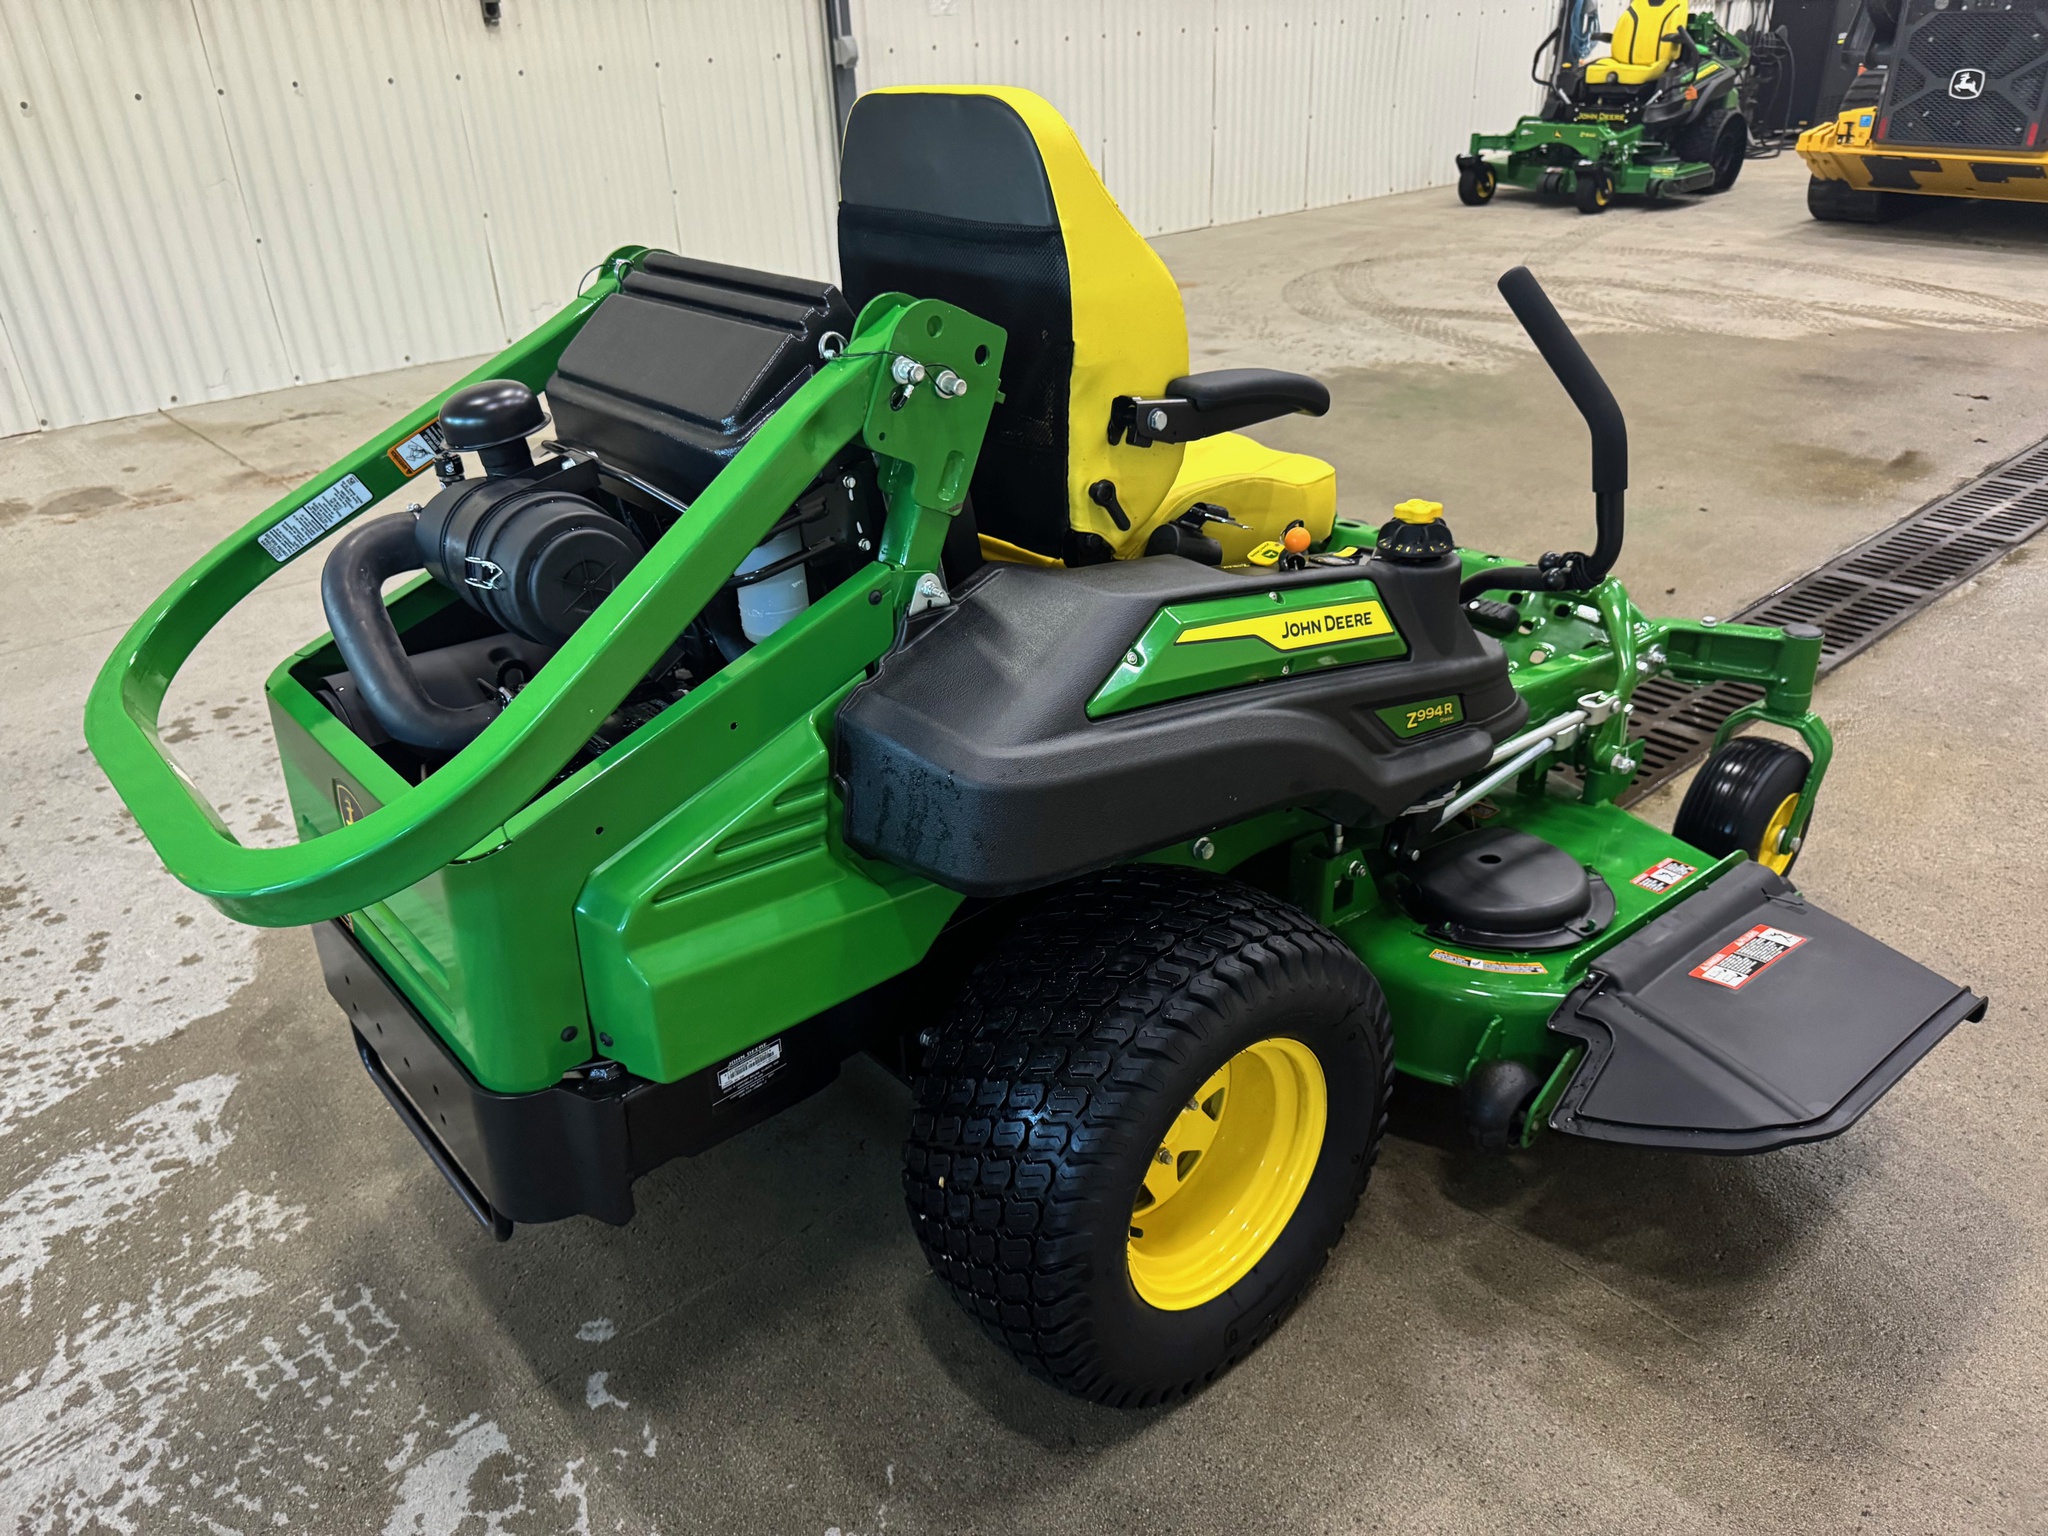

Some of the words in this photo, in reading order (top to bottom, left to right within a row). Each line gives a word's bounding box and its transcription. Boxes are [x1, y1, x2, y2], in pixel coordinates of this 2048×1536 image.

[1577, 112, 1598, 120] JOHN
[1599, 112, 1625, 121] DEERE
[1282, 619, 1322, 639] JOHN
[1324, 612, 1373, 632] DEERE
